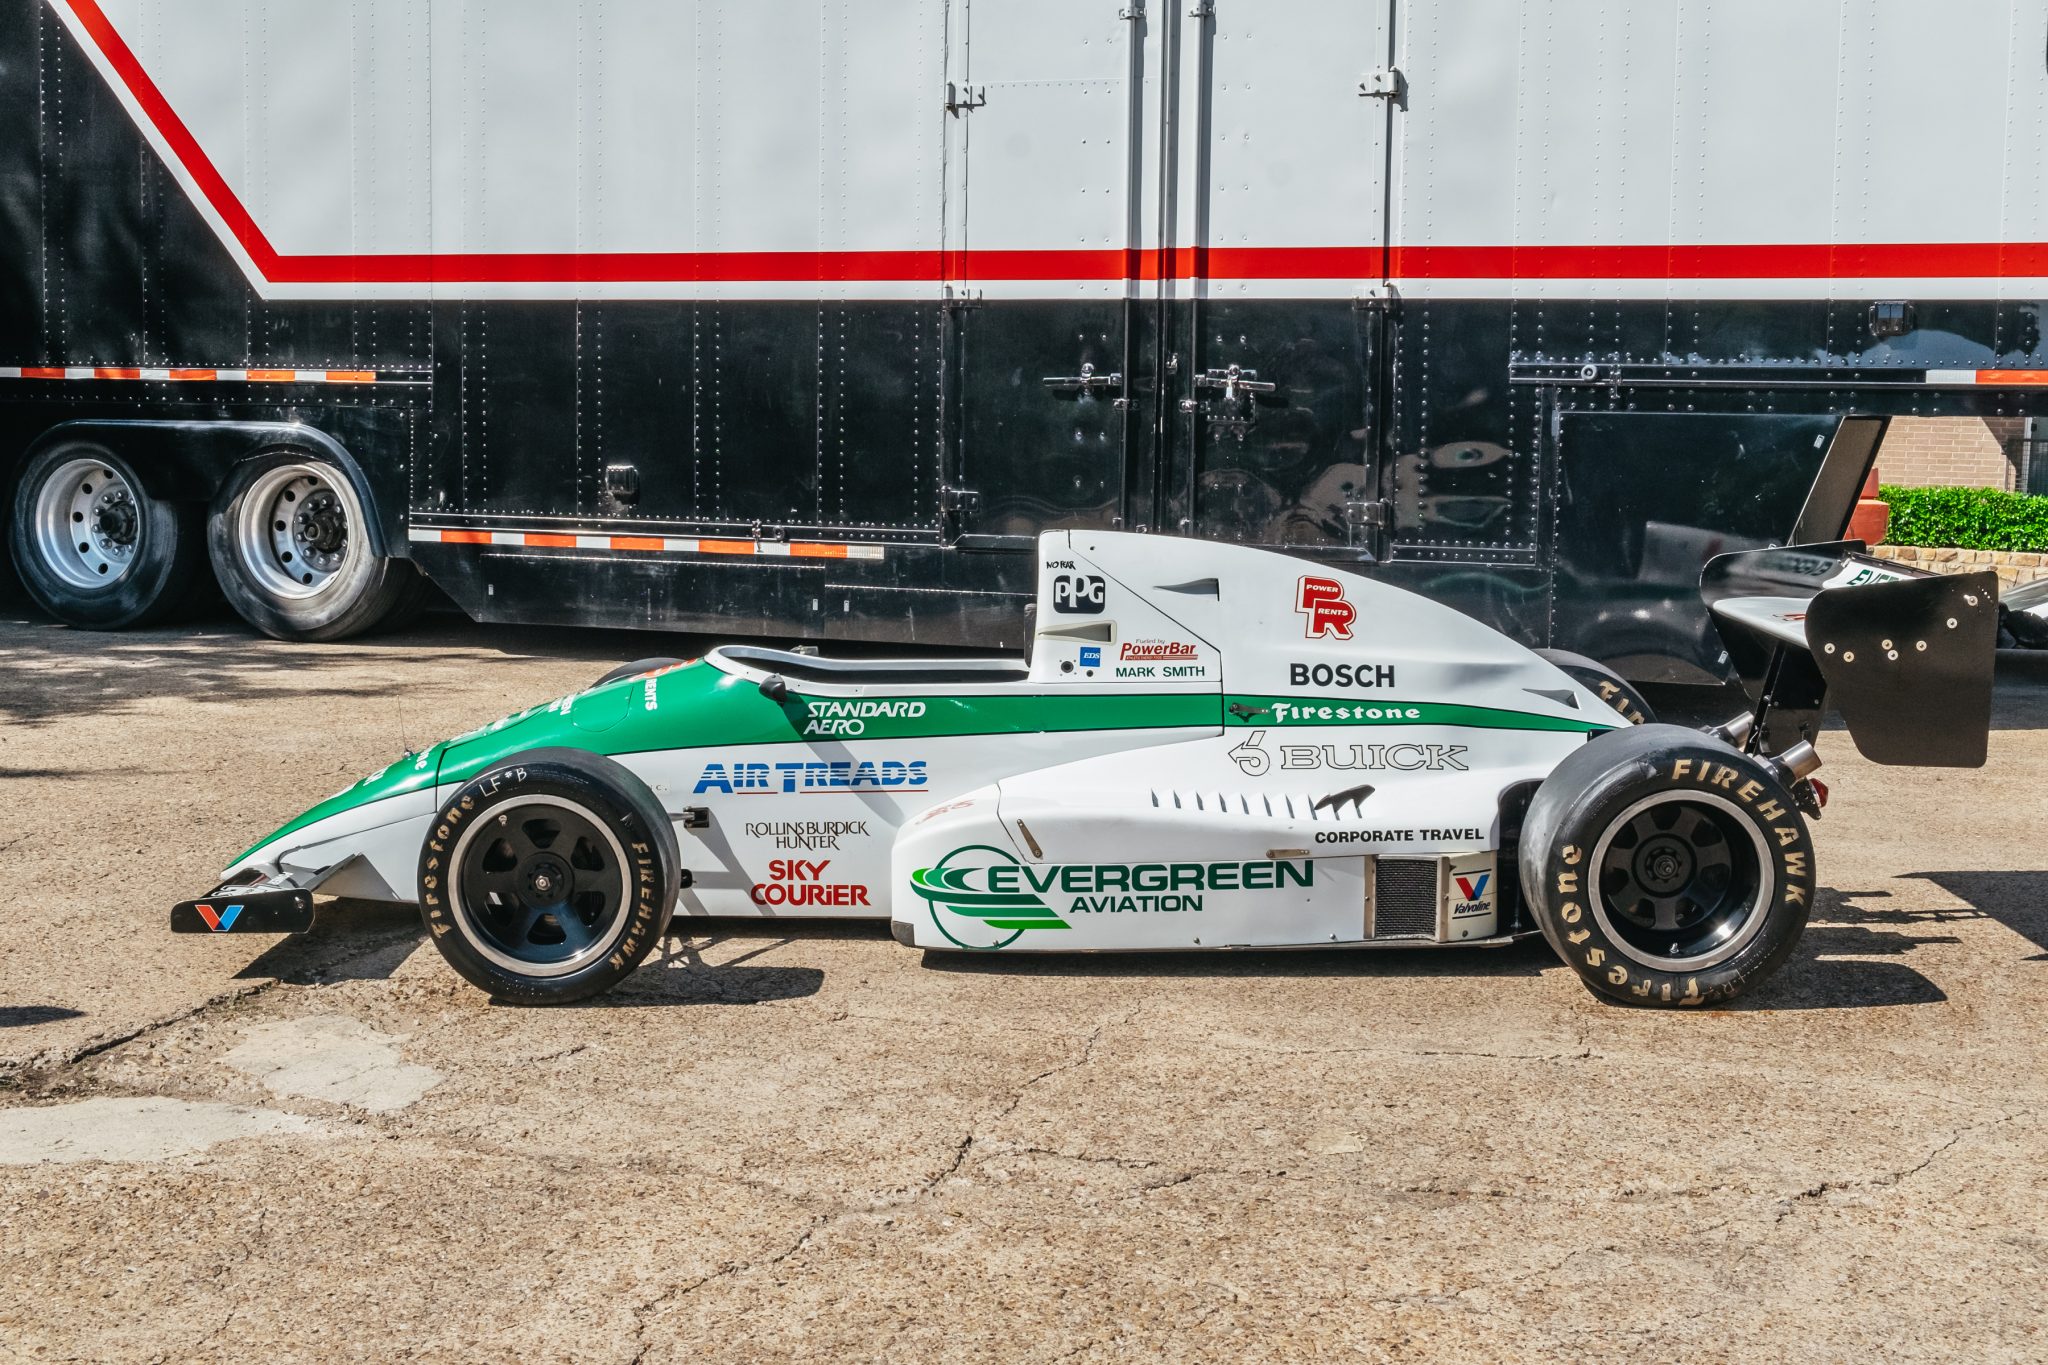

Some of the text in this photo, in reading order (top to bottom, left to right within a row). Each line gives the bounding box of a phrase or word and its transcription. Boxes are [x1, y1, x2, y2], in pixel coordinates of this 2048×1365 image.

[1055, 575, 1104, 608] PPG
[1306, 584, 1339, 593] POWER
[1317, 607, 1349, 616] RENTS
[1120, 642, 1196, 660] PowerBar
[1116, 666, 1205, 677] MARK SMITH
[1290, 663, 1395, 688] BOSCH
[807, 701, 926, 718] STANDARD
[1271, 702, 1421, 724] Firestone
[803, 719, 865, 735] AERO
[1280, 744, 1469, 771] BUICK
[745, 821, 870, 838] ROLLINS BURDICK
[1315, 828, 1484, 844] CORPORATE TRAVEL
[1672, 758, 1806, 905] FIREHAWK
[776, 836, 840, 851] HUNTER
[424, 795, 476, 939] Firestone
[768, 859, 831, 881] SKY
[987, 860, 1314, 893] EVERGREEN
[1069, 895, 1203, 913] AVIATION
[1454, 901, 1490, 914] Valvoline
[1557, 844, 1705, 1006] Firestone
